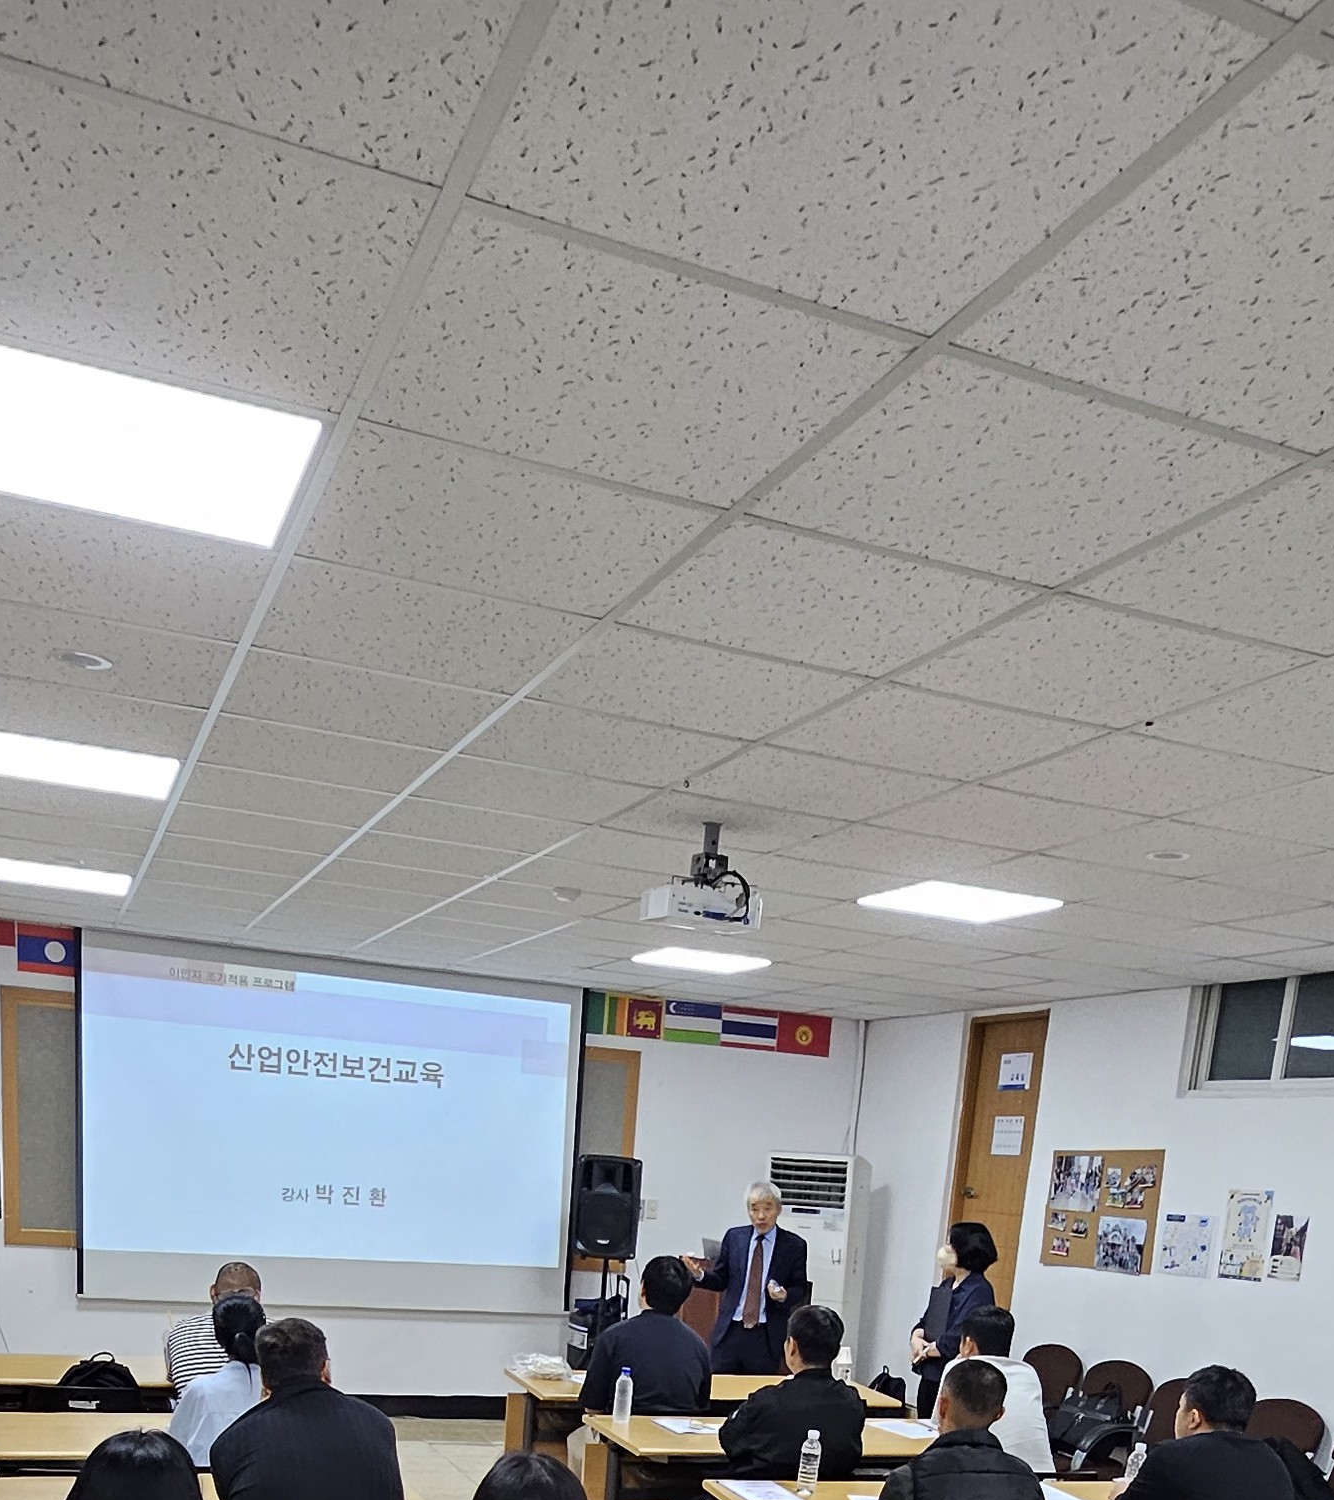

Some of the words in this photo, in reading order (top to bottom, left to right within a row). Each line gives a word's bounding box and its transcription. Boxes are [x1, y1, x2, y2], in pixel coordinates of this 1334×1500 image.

[253, 977, 295, 991] 프로그램
[228, 1043, 445, 1089] 산업안전보건교육
[281, 1187, 309, 1203] 강사
[316, 1184, 334, 1204] 박
[342, 1186, 360, 1206] 진
[369, 1187, 387, 1207] 환
